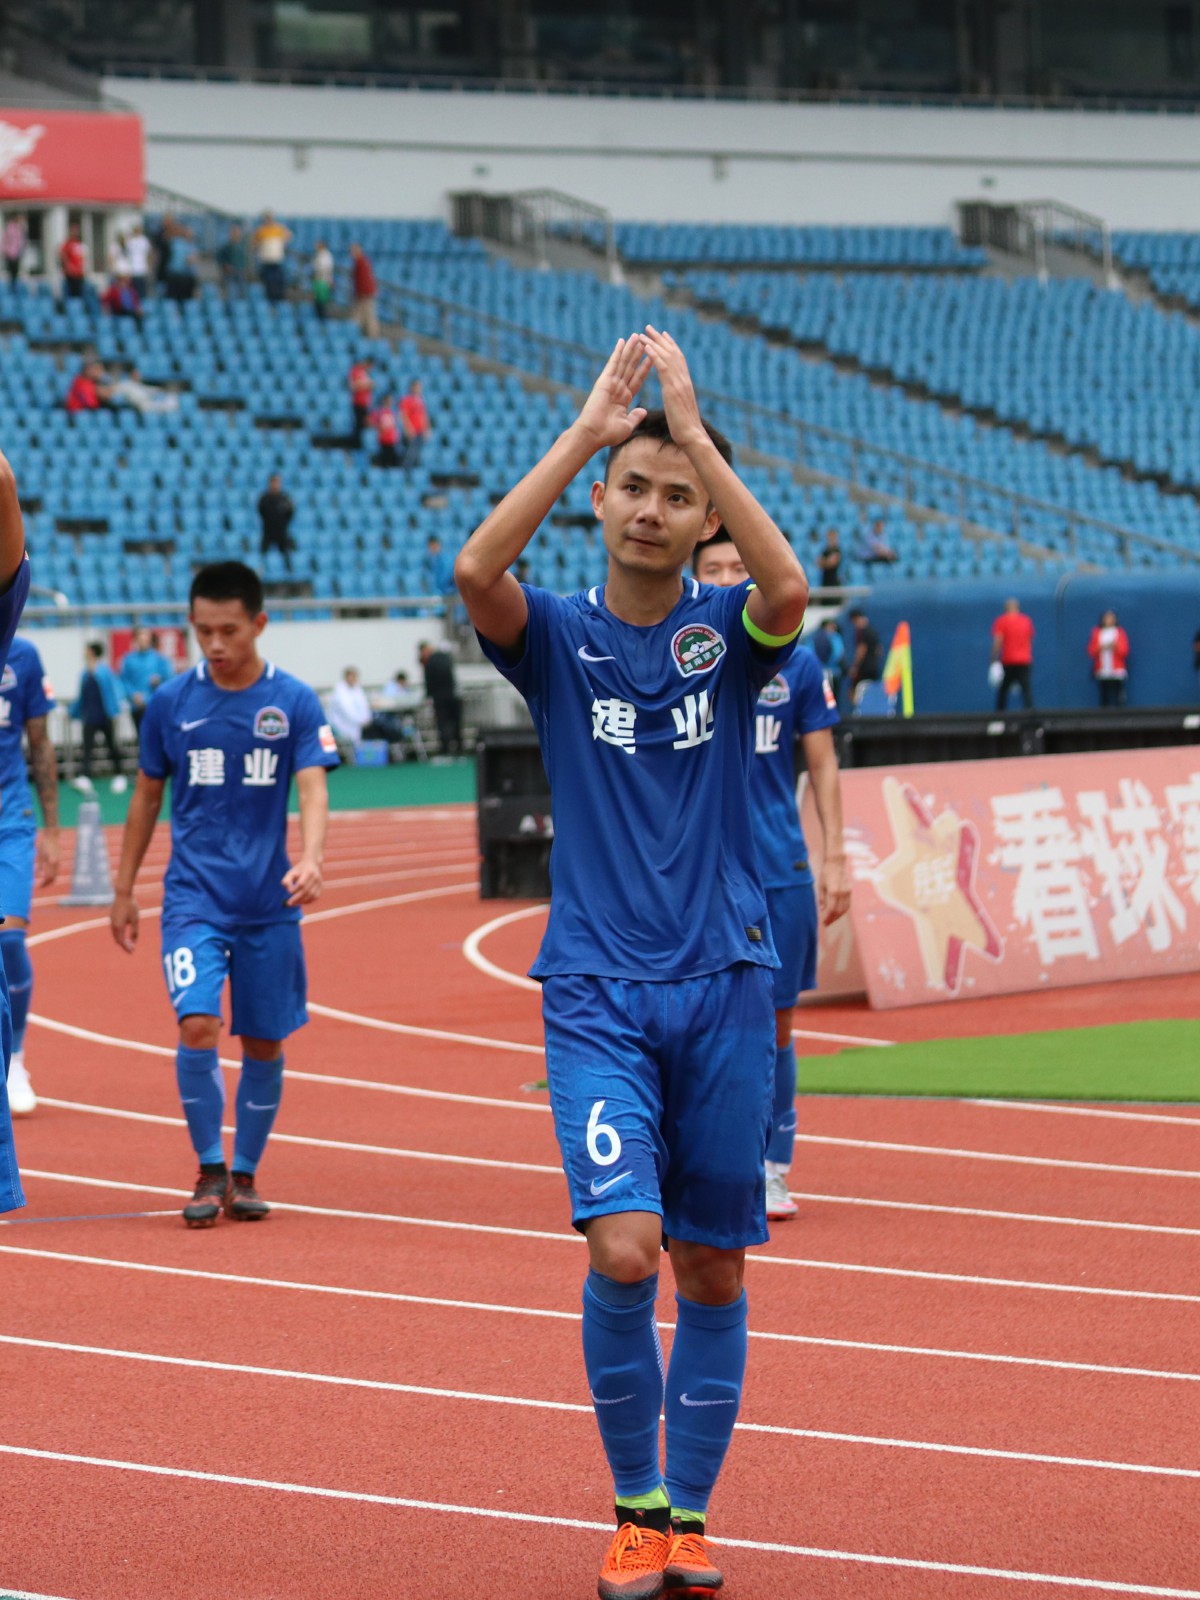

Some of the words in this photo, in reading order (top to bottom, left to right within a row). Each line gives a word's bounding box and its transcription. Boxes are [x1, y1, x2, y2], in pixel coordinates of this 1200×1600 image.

[591, 689, 714, 754] 建业
[187, 748, 279, 787] 建业
[164, 946, 197, 993] 18
[586, 1100, 622, 1166] 6
